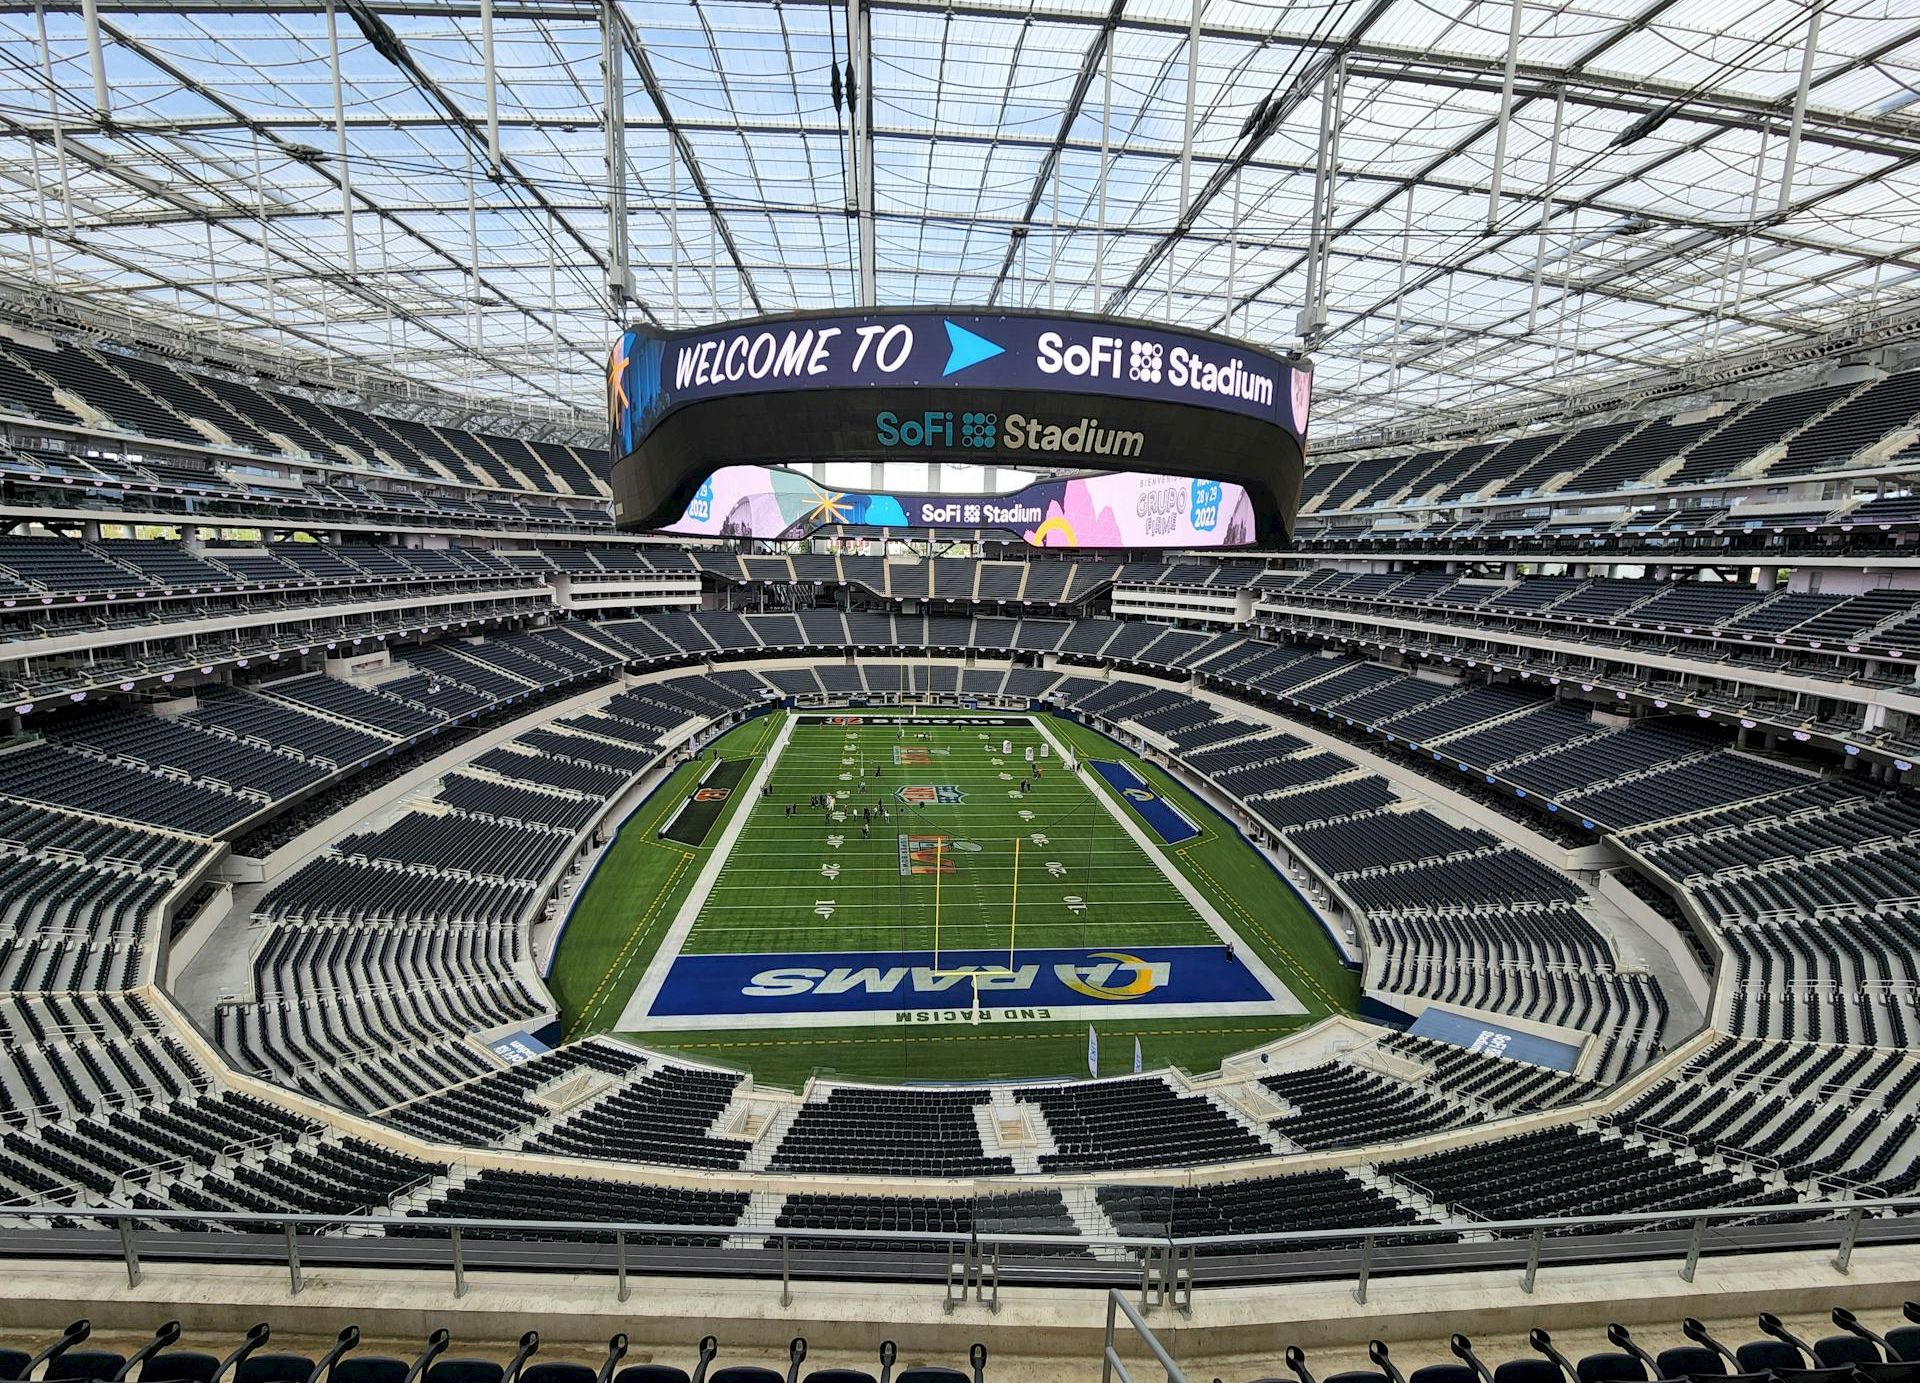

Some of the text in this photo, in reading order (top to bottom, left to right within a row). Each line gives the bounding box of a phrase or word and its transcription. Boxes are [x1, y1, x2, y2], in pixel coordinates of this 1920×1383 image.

[675, 324, 914, 390] WELCOME TO
[1036, 332, 1273, 406] SoFi Stadium
[876, 411, 1145, 457] SoFi Stadium
[689, 500, 709, 518] 2022
[1136, 486, 1187, 518] GRUPO
[921, 503, 1042, 524] SoFi Stadium
[1194, 505, 1216, 528] 2022
[820, 863, 841, 877] 20
[1044, 861, 1068, 875] 20
[814, 899, 836, 916] 10
[1063, 895, 1088, 910] 10
[741, 964, 1041, 997] RAMS
[896, 1008, 1051, 1024] END RACISM
